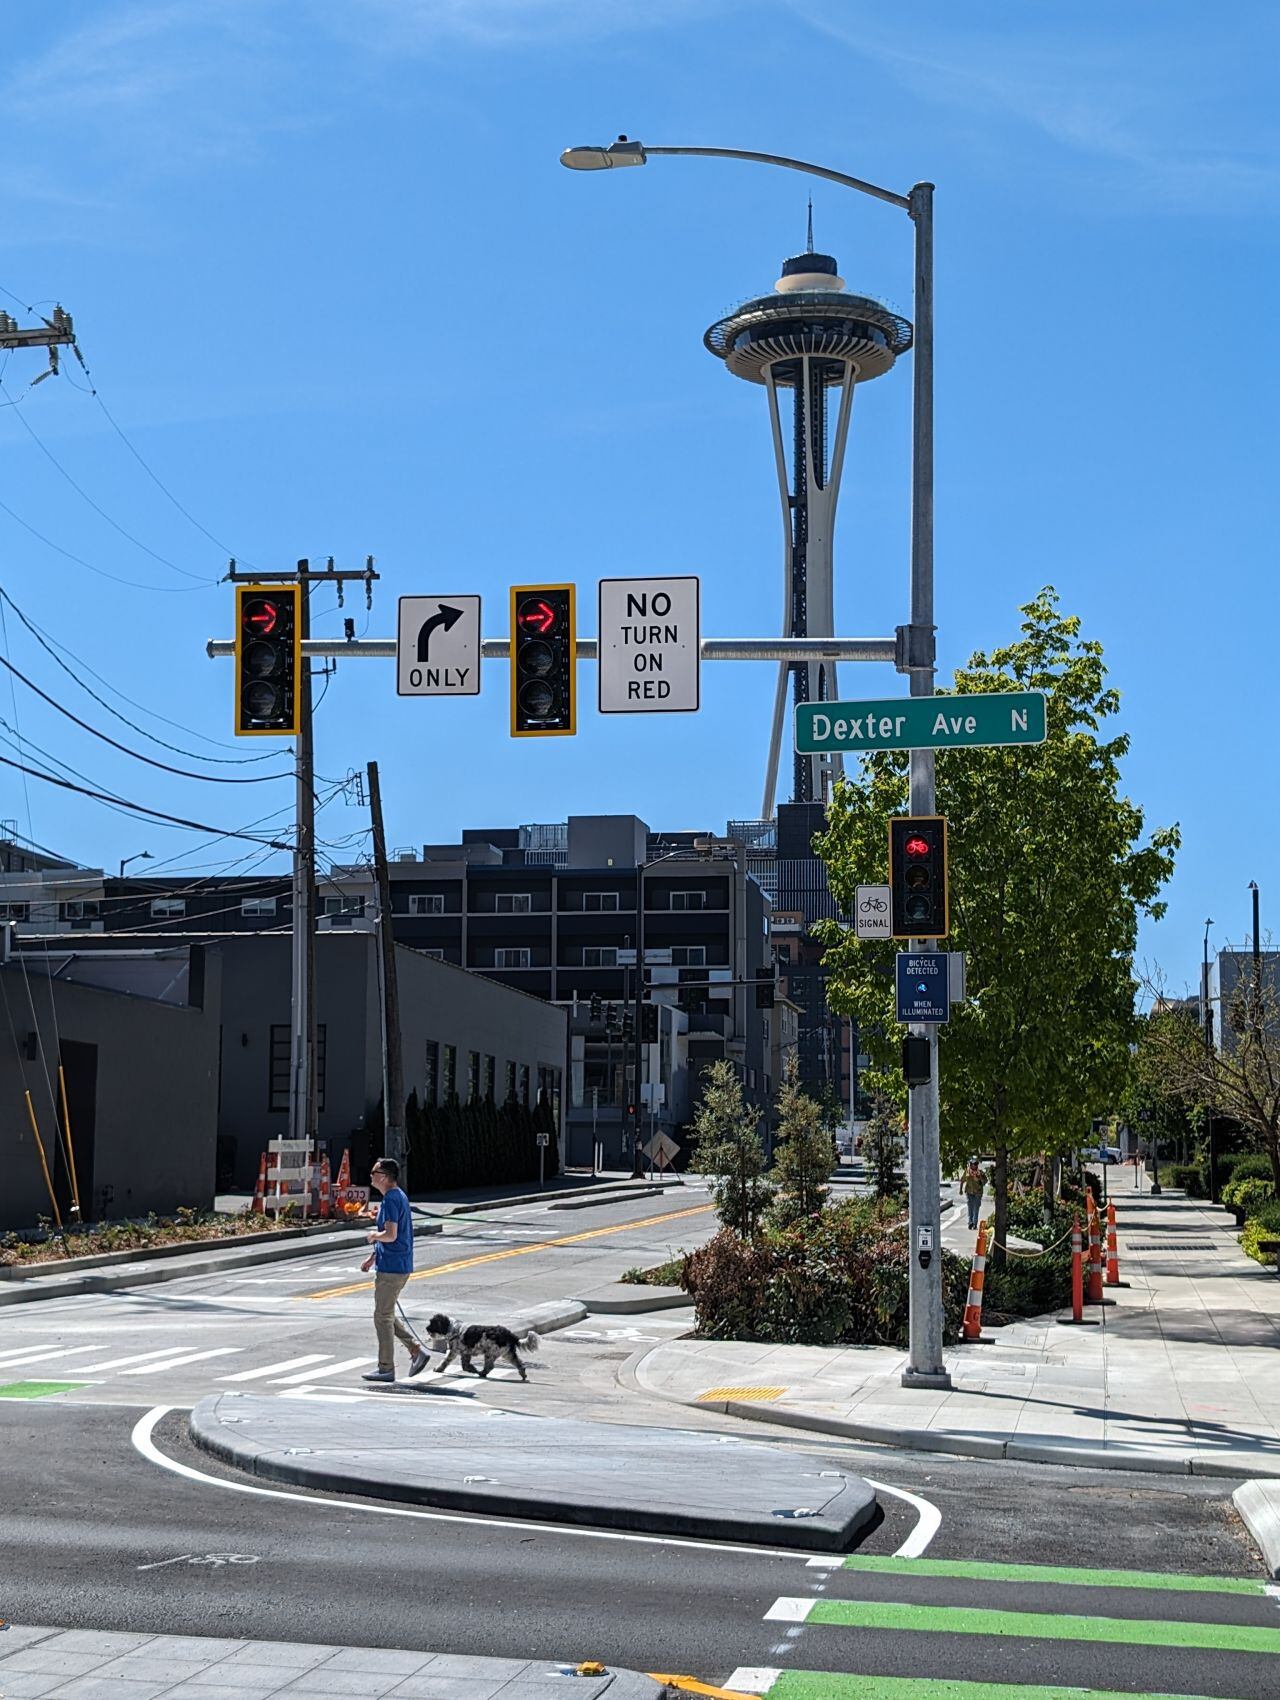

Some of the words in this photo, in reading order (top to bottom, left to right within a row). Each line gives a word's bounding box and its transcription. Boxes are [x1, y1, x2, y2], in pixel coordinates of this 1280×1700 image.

[626, 592, 672, 617] NO
[620, 625, 678, 645] TURN
[633, 653, 663, 672] ON
[409, 667, 470, 687] ONLY
[628, 680, 671, 699] RED
[812, 712, 906, 741] Dexter
[931, 712, 977, 736] Ave
[1011, 708, 1028, 732] N
[858, 918, 889, 928] SIGNAL
[906, 967, 939, 975] DETECTED
[908, 959, 936, 967] BICYCLE
[902, 1008, 944, 1016] ILLUMINATED
[913, 1000, 932, 1008] WHEN
